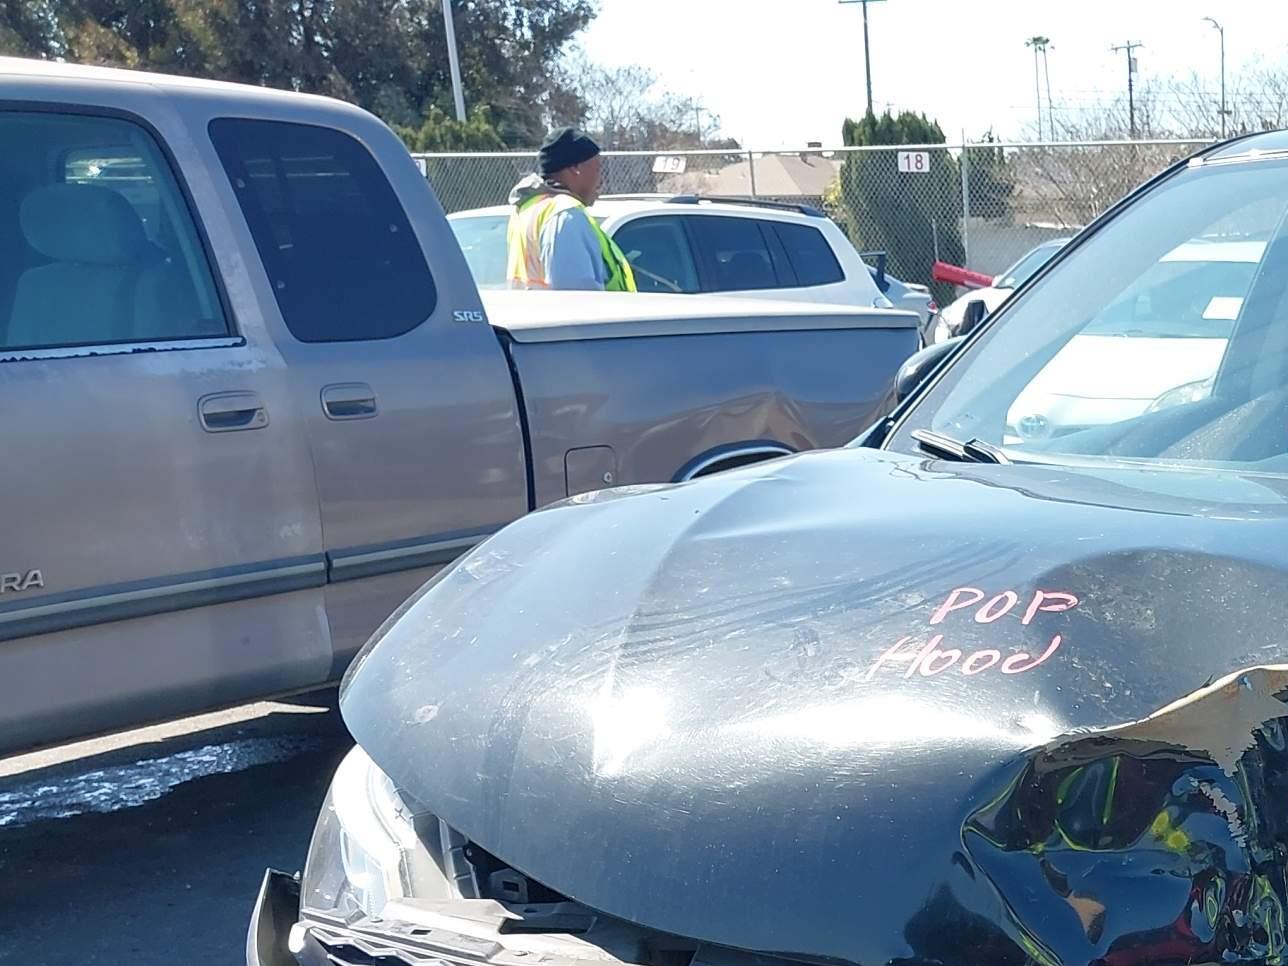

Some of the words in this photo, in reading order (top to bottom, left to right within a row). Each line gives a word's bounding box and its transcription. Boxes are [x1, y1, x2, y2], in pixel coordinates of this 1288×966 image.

[664, 156, 681, 171] 19
[904, 153, 923, 170] 18
[0, 569, 44, 592] RA
[929, 587, 1079, 625] POP
